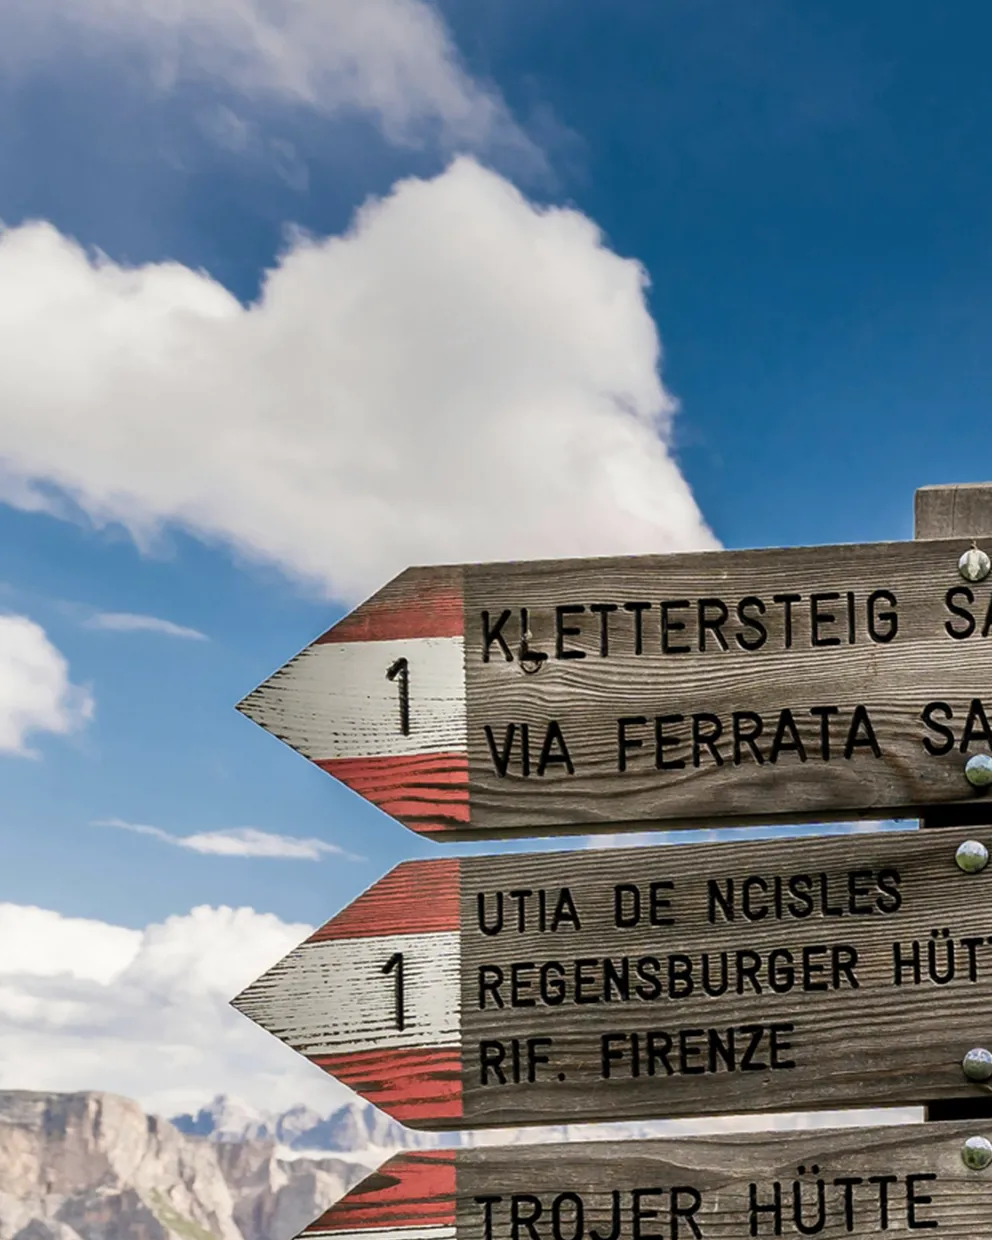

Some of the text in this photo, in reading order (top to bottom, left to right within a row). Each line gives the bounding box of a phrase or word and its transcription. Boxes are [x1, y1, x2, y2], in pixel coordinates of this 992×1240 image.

[481, 589, 899, 664] KLETTERSTEIG
[386, 656, 411, 737] 1
[484, 720, 576, 779] VIA
[617, 704, 883, 773] FERRATA
[475, 867, 904, 936] UTIA DE NCISLES
[382, 952, 405, 1032] 1
[477, 945, 860, 1010] REGENSBURGER
[479, 1023, 797, 1086] RIF. FIRENZE
[748, 1165, 938, 1237] HÜTTE
